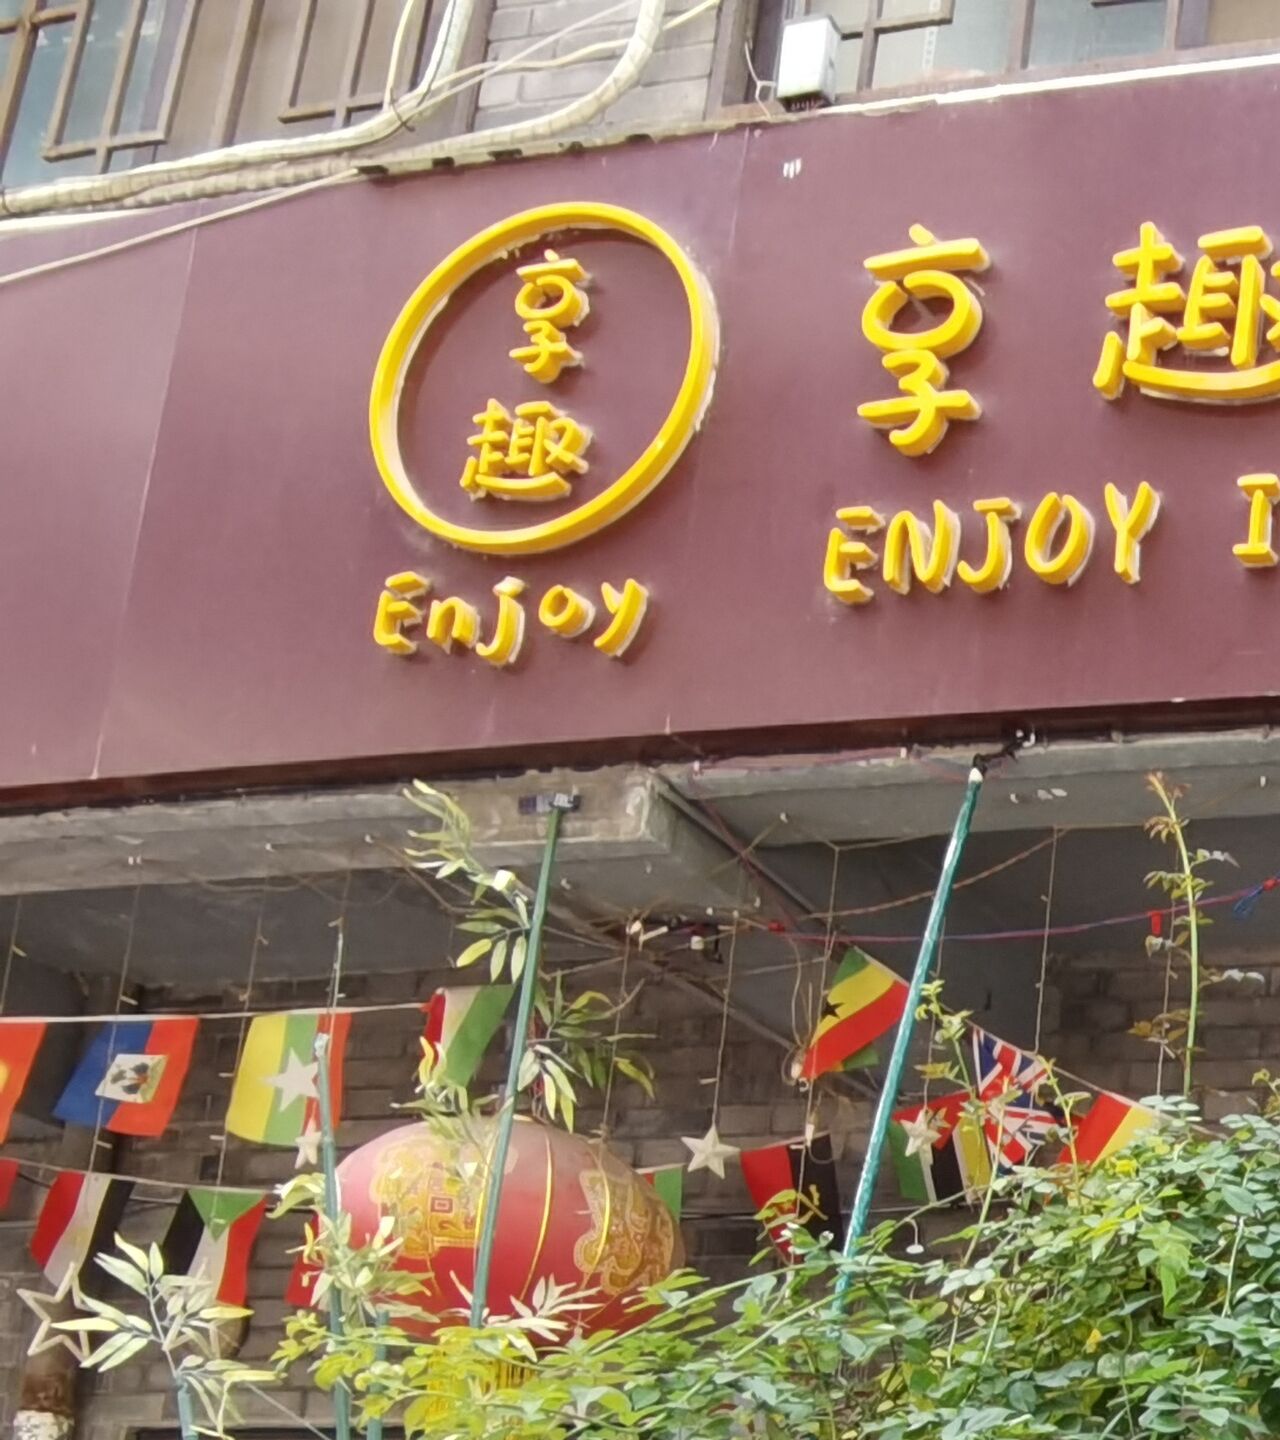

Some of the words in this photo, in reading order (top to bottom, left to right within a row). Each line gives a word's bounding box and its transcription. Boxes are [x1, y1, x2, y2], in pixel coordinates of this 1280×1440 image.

[460, 250, 592, 500] 享趣
[823, 481, 1161, 604] ENJOY
[372, 571, 650, 666] Enjoy
